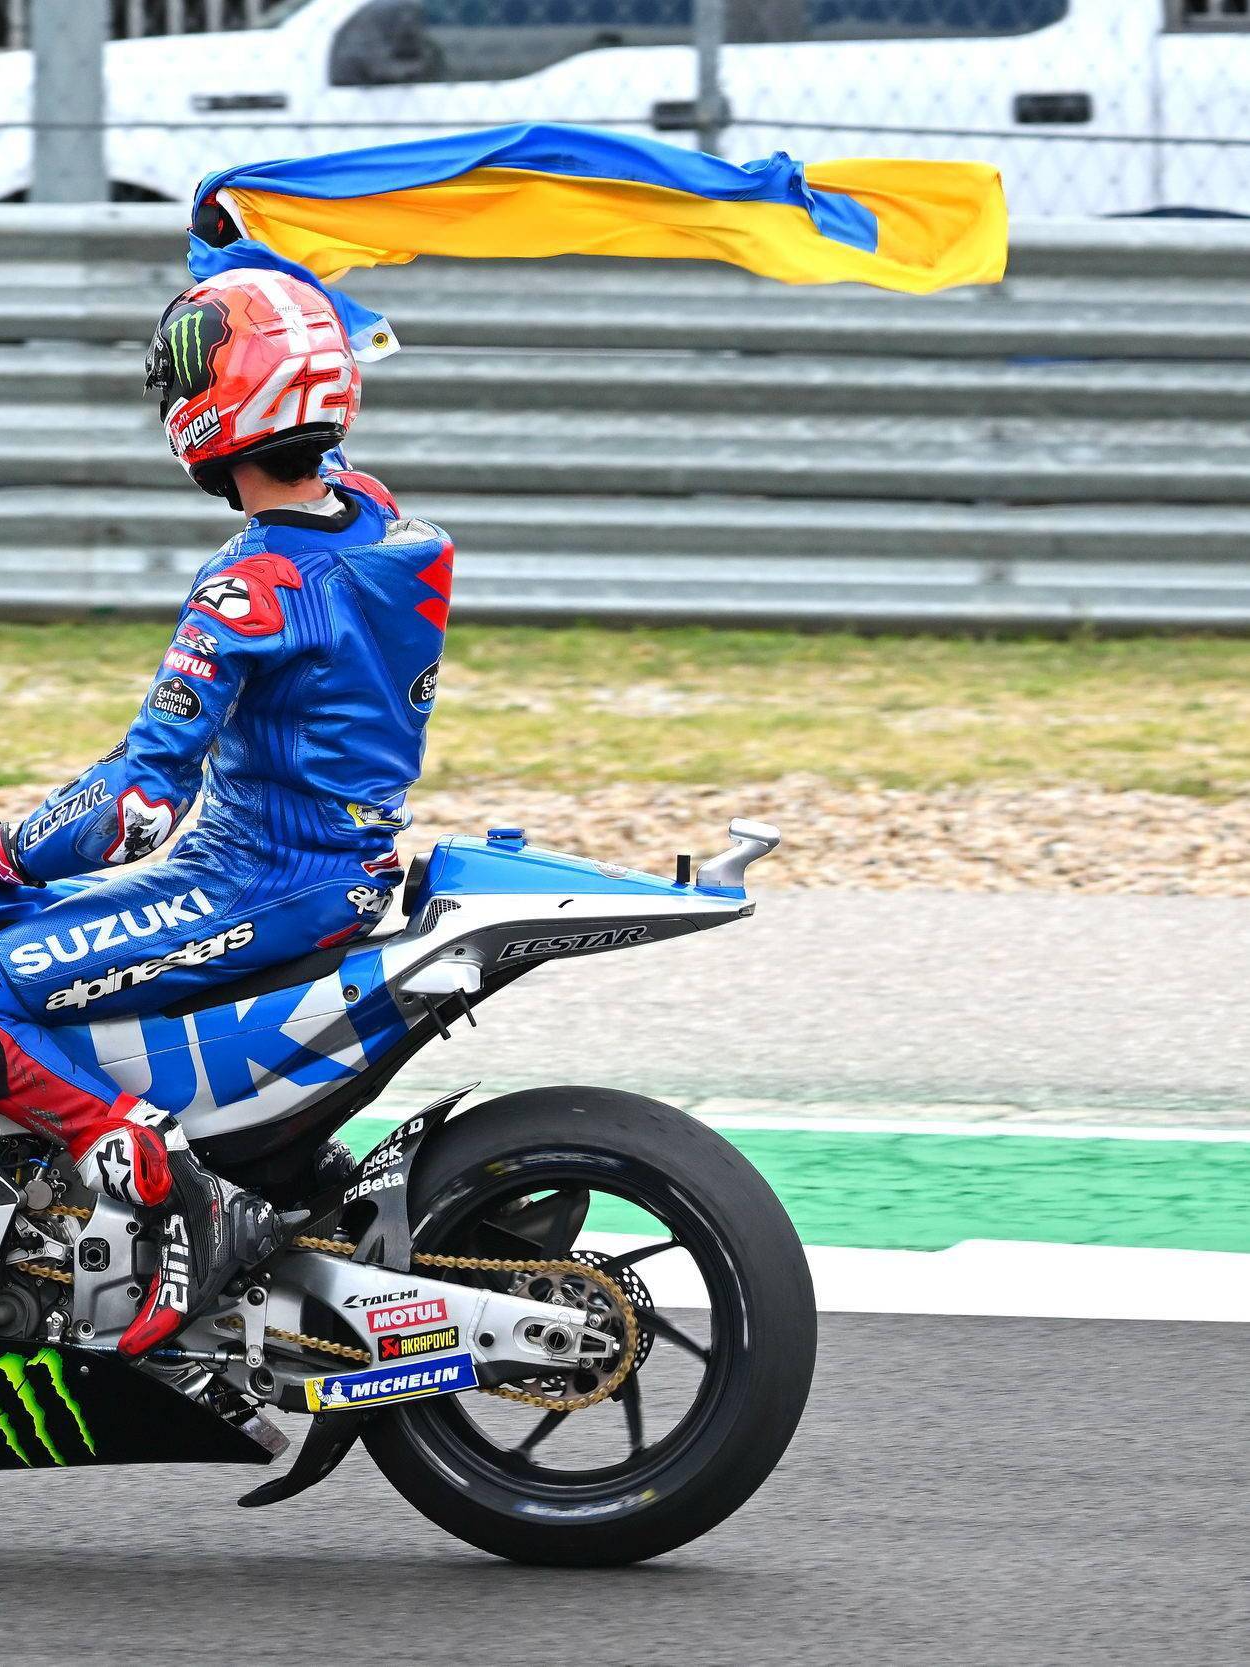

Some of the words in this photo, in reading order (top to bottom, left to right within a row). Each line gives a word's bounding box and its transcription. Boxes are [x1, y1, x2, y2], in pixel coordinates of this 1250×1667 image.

[233, 351, 352, 442] 42
[165, 651, 212, 678] MOTUL
[155, 697, 188, 716] Galicia
[157, 686, 192, 706] Estrella
[23, 778, 114, 851] ECSTAR
[9, 886, 215, 975] SUZUKI
[497, 925, 654, 962] ECSTAR
[45, 921, 255, 1010] alpinestars
[362, 1141, 403, 1174] NGK
[358, 1172, 405, 1197] Beta
[360, 1288, 418, 1307] TAICHI
[373, 1303, 443, 1329] MOTUL
[351, 1366, 460, 1399] MICHELIN
